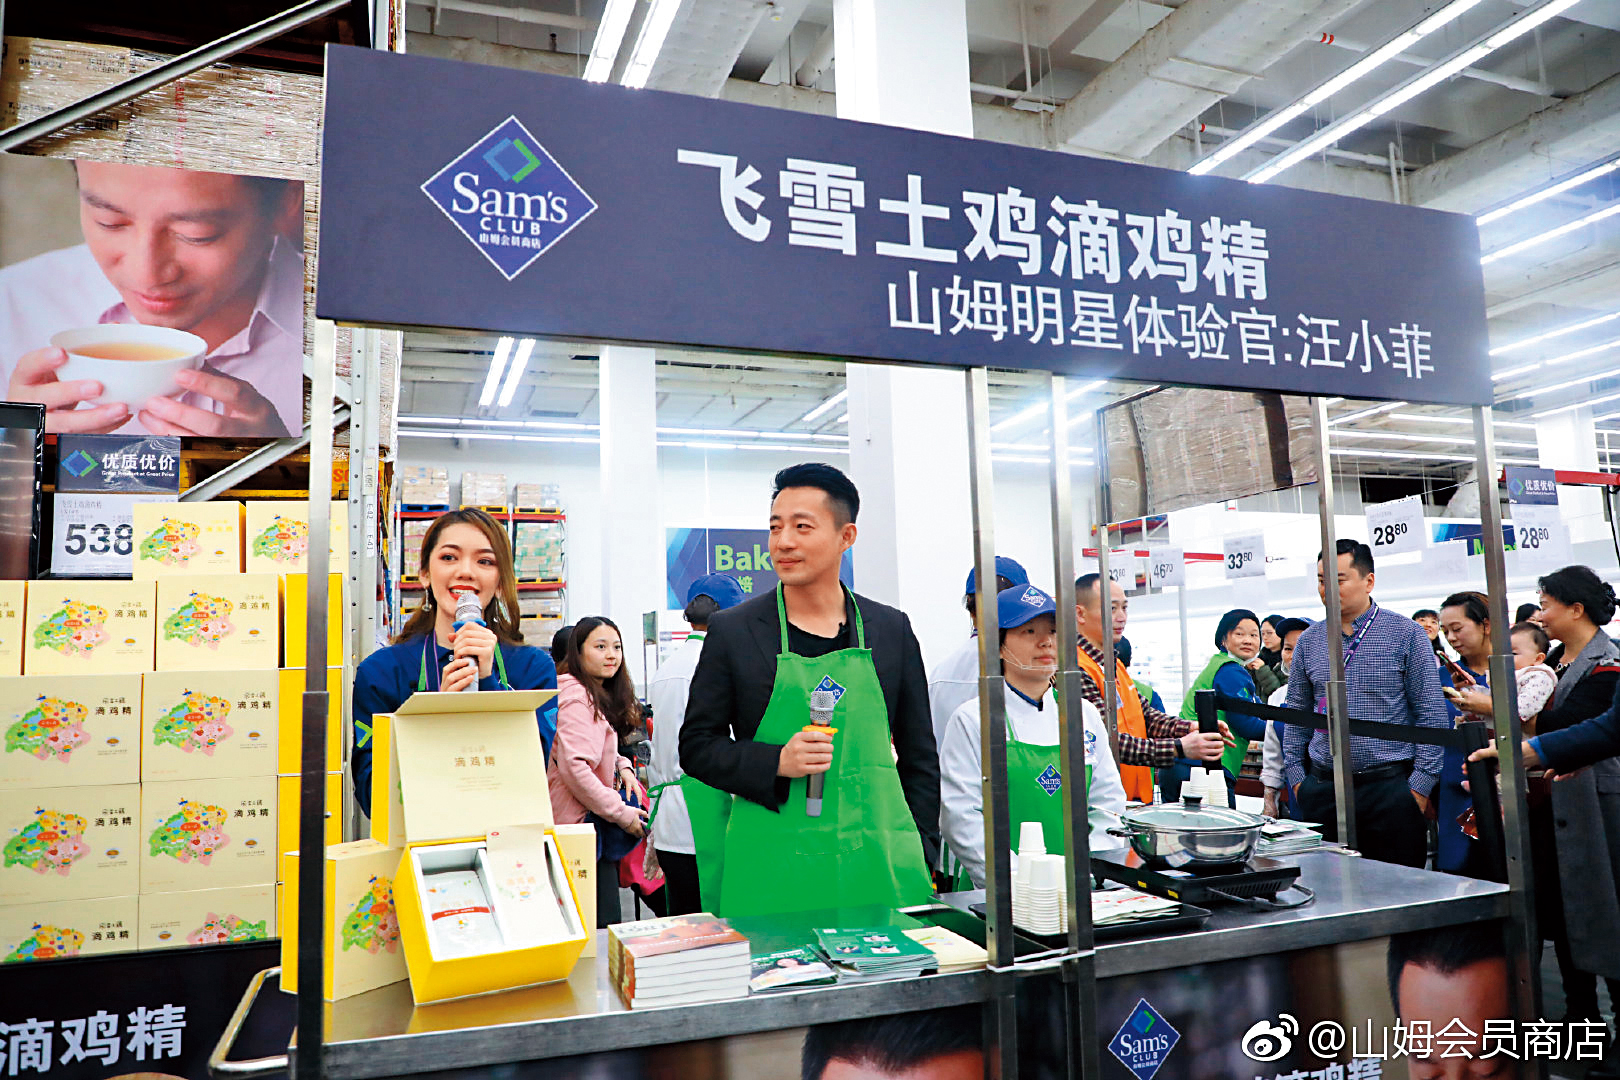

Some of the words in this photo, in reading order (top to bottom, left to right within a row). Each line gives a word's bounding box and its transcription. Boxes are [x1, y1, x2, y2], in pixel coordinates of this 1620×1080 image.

[452, 171, 568, 223] Sam's
[479, 216, 541, 236] CLUB
[676, 148, 1270, 301] 飞雪土鸡滴鸡精
[887, 269, 1435, 380] 山姆明星体验官:汪小菲
[101, 453, 175, 471] 优质优价
[65, 523, 133, 555] 538
[0, 1003, 187, 1077] 滴鸡精
[1120, 1033, 1169, 1057] Sam's
[1132, 1051, 1158, 1063] CLUB
